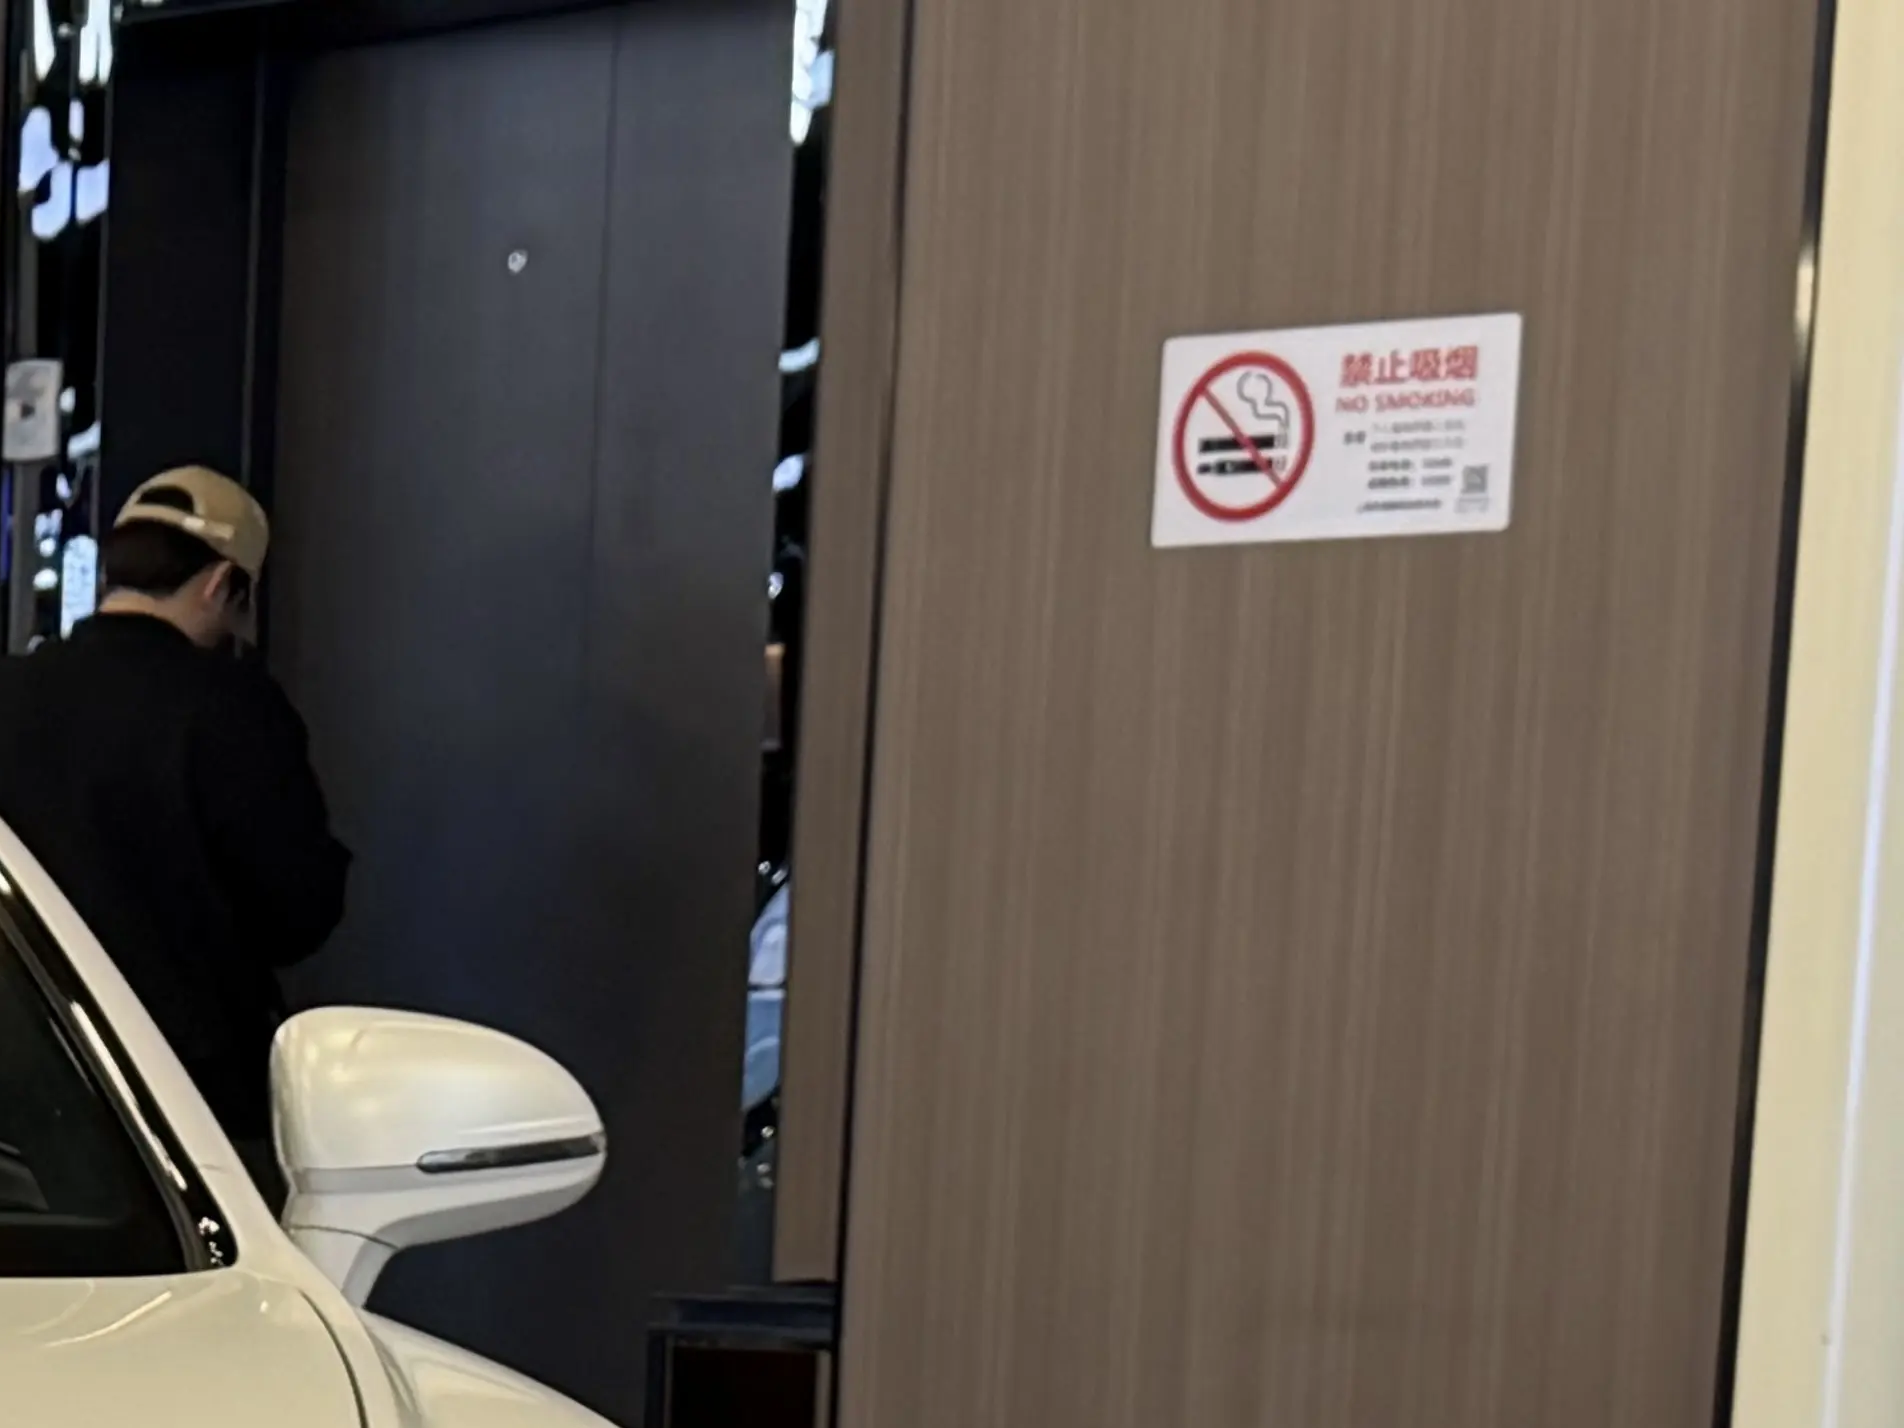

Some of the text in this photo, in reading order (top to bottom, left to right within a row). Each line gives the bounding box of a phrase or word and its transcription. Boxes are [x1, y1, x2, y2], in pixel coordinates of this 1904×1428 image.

[1339, 345, 1479, 387] 禁止吸烟
[1335, 388, 1476, 414] NO SMOKING
